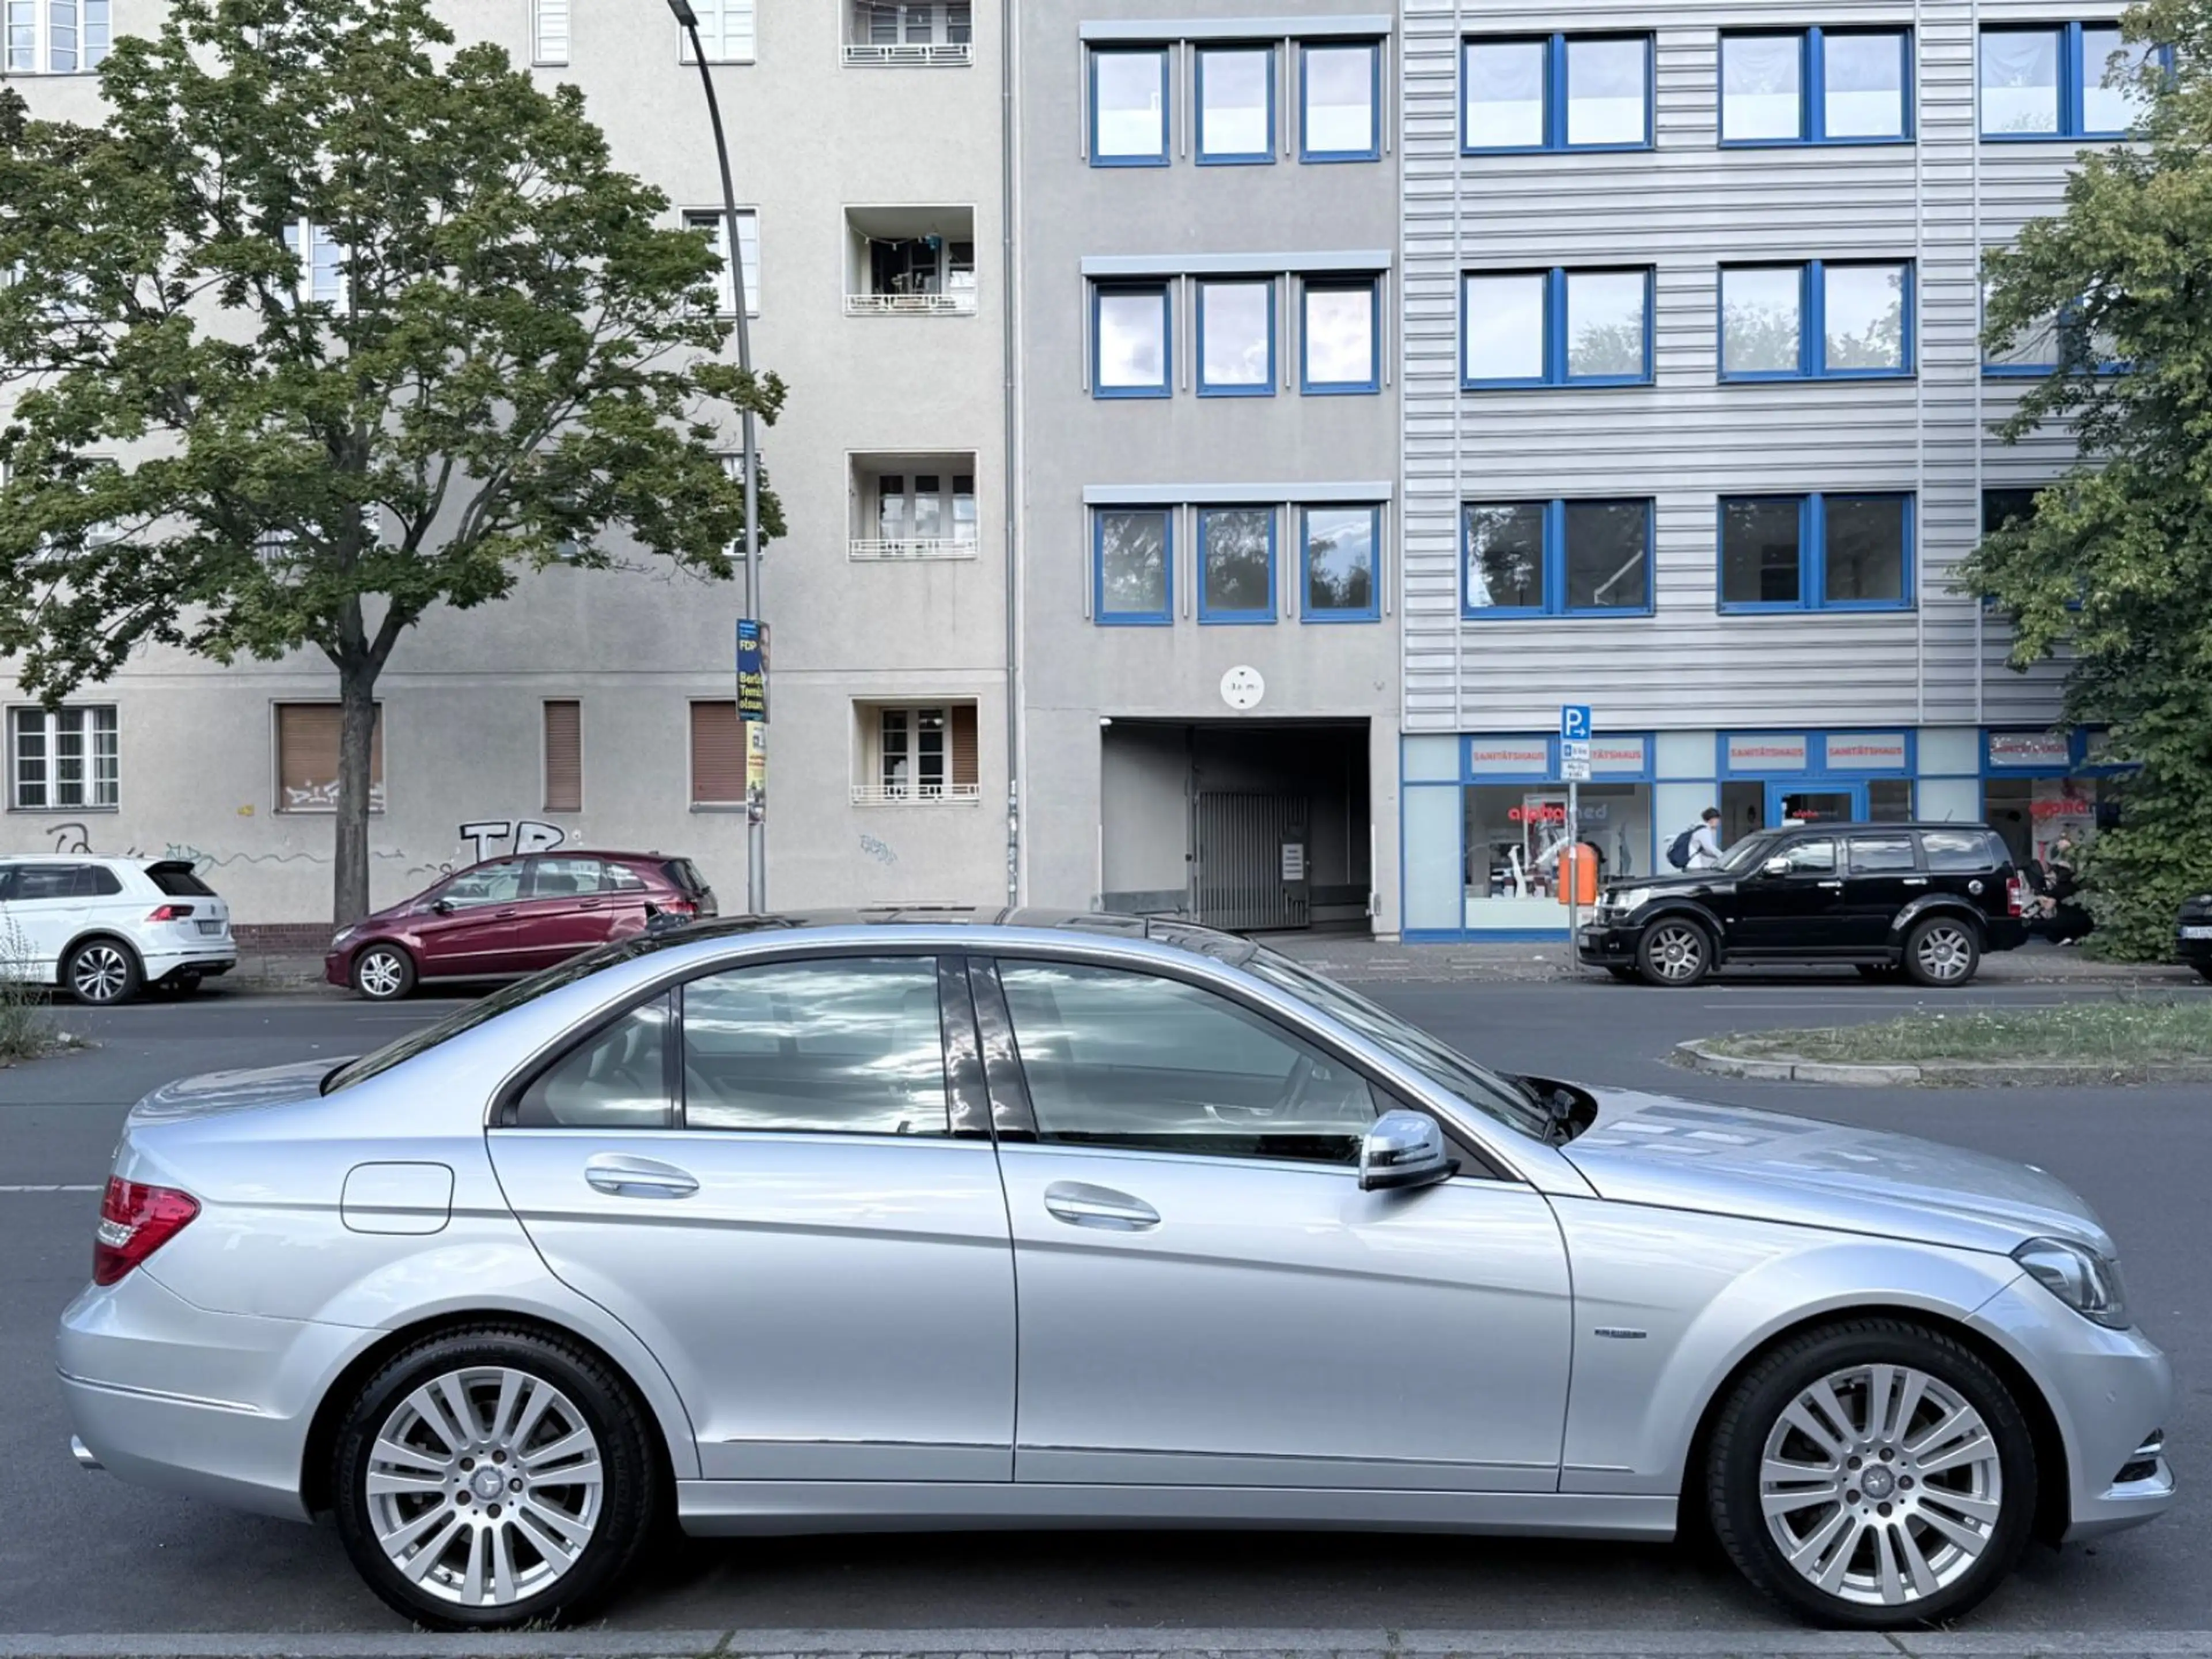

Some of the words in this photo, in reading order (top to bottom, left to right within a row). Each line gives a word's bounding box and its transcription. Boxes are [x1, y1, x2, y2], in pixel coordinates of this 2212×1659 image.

[740, 639, 757, 652] FDP
[1566, 708, 1582, 736] P
[1592, 748, 1641, 760] TÄTSHAUS
